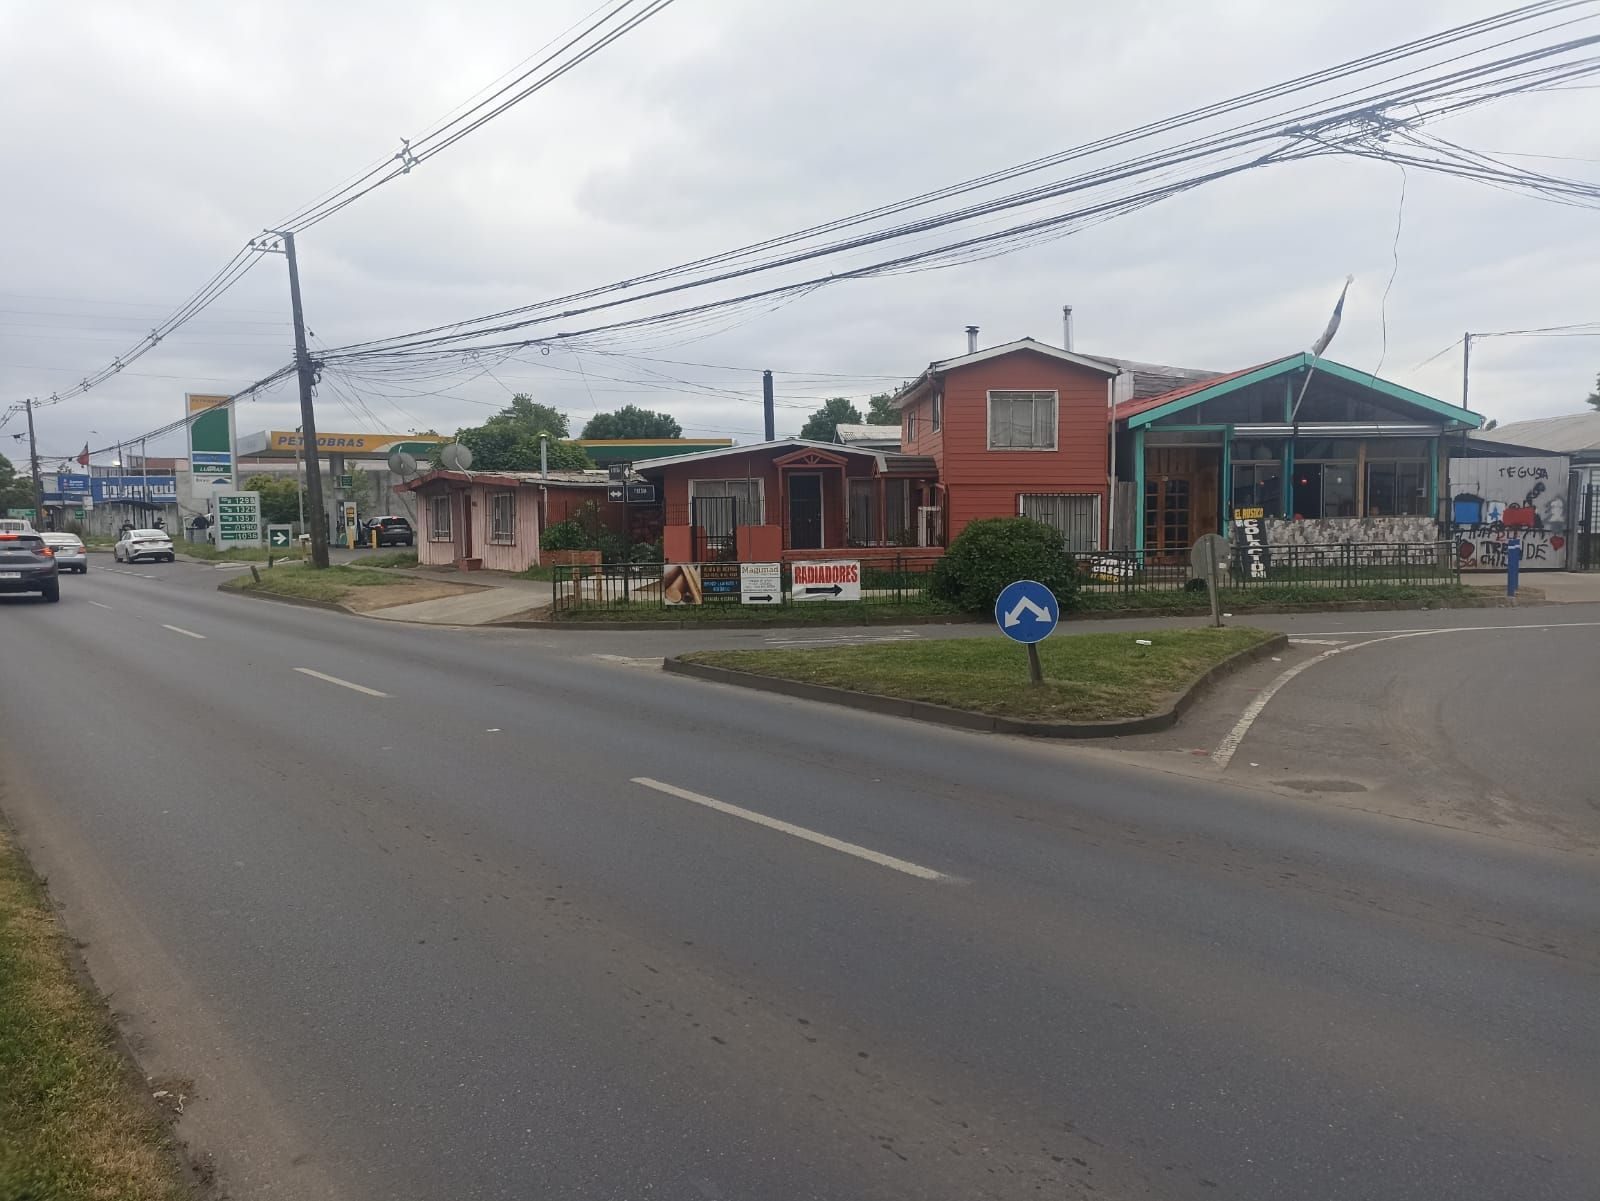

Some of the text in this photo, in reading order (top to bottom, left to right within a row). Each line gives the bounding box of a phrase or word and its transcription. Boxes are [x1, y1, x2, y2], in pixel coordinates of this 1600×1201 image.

[278, 436, 365, 448] PETOBRAS
[1480, 555, 1509, 567] CHIL
[794, 564, 858, 585] RADIADORES
